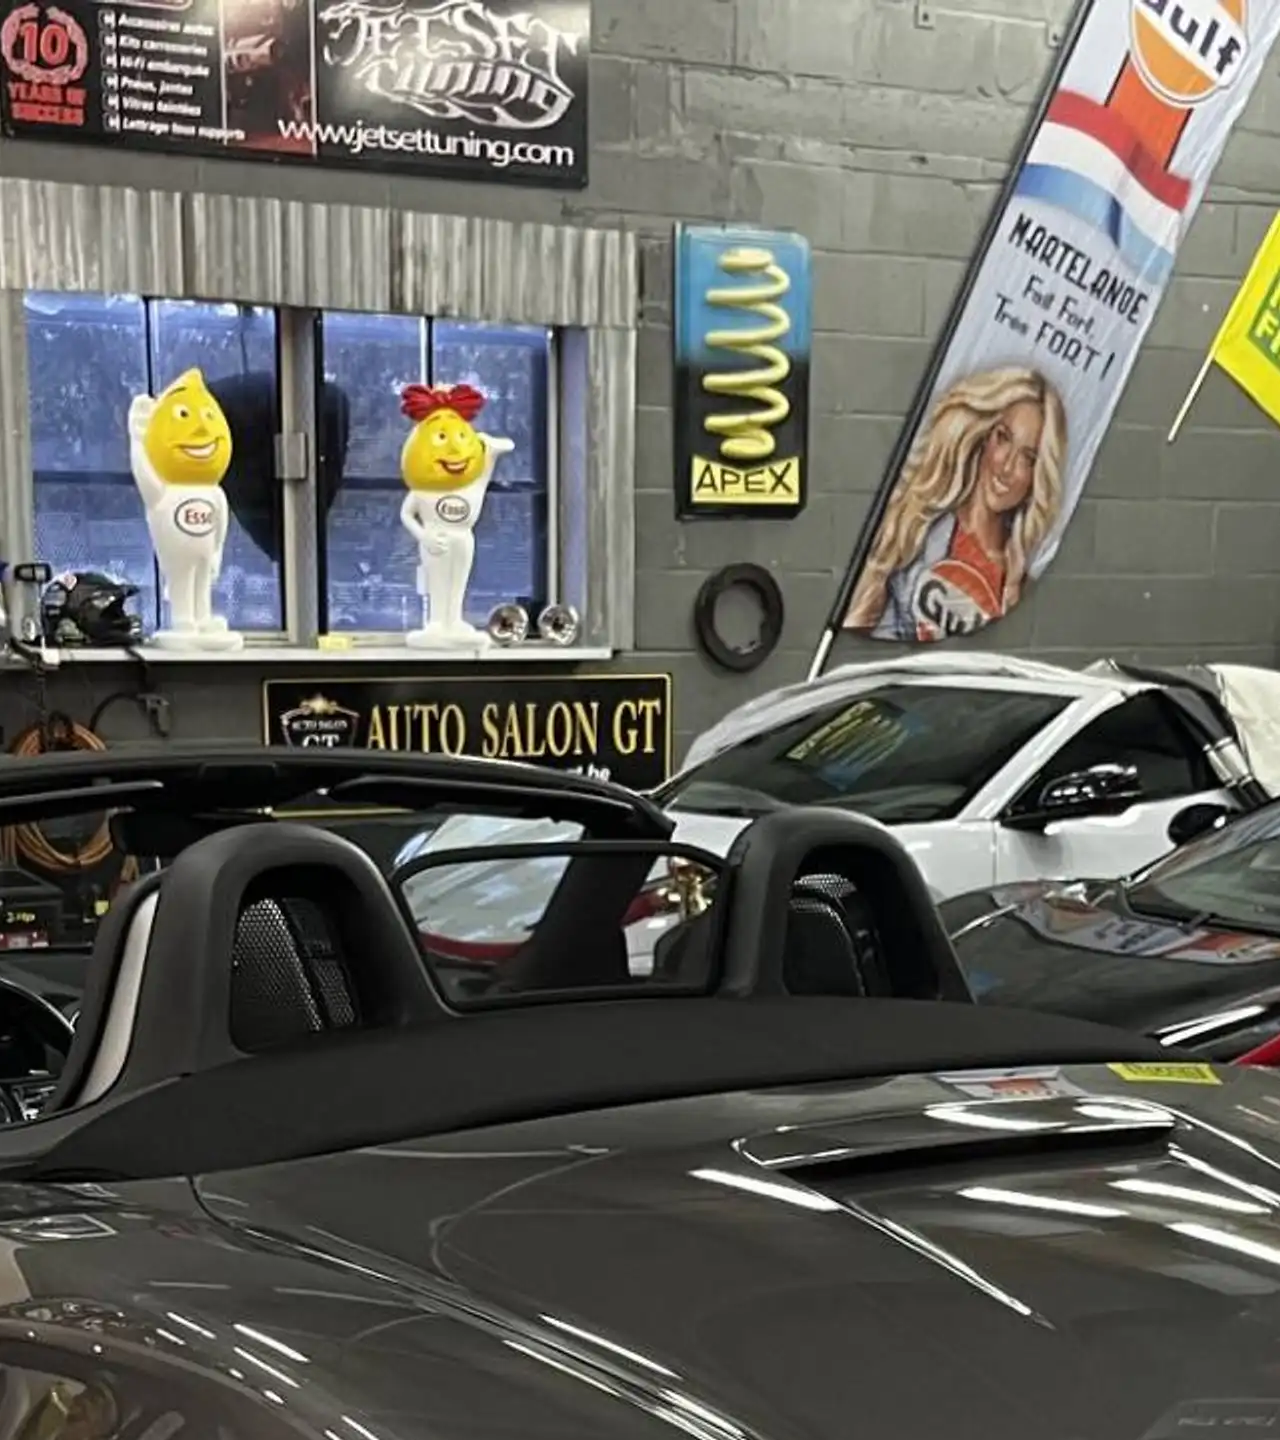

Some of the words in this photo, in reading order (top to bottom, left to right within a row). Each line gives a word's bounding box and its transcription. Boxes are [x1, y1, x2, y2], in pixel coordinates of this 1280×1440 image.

[19, 22, 70, 66] 10
[277, 119, 575, 167] www.jetsettuning.com
[695, 462, 793, 493] APEX
[368, 704, 466, 757] AUTO
[481, 702, 600, 758] SALON
[613, 698, 661, 755] GT
